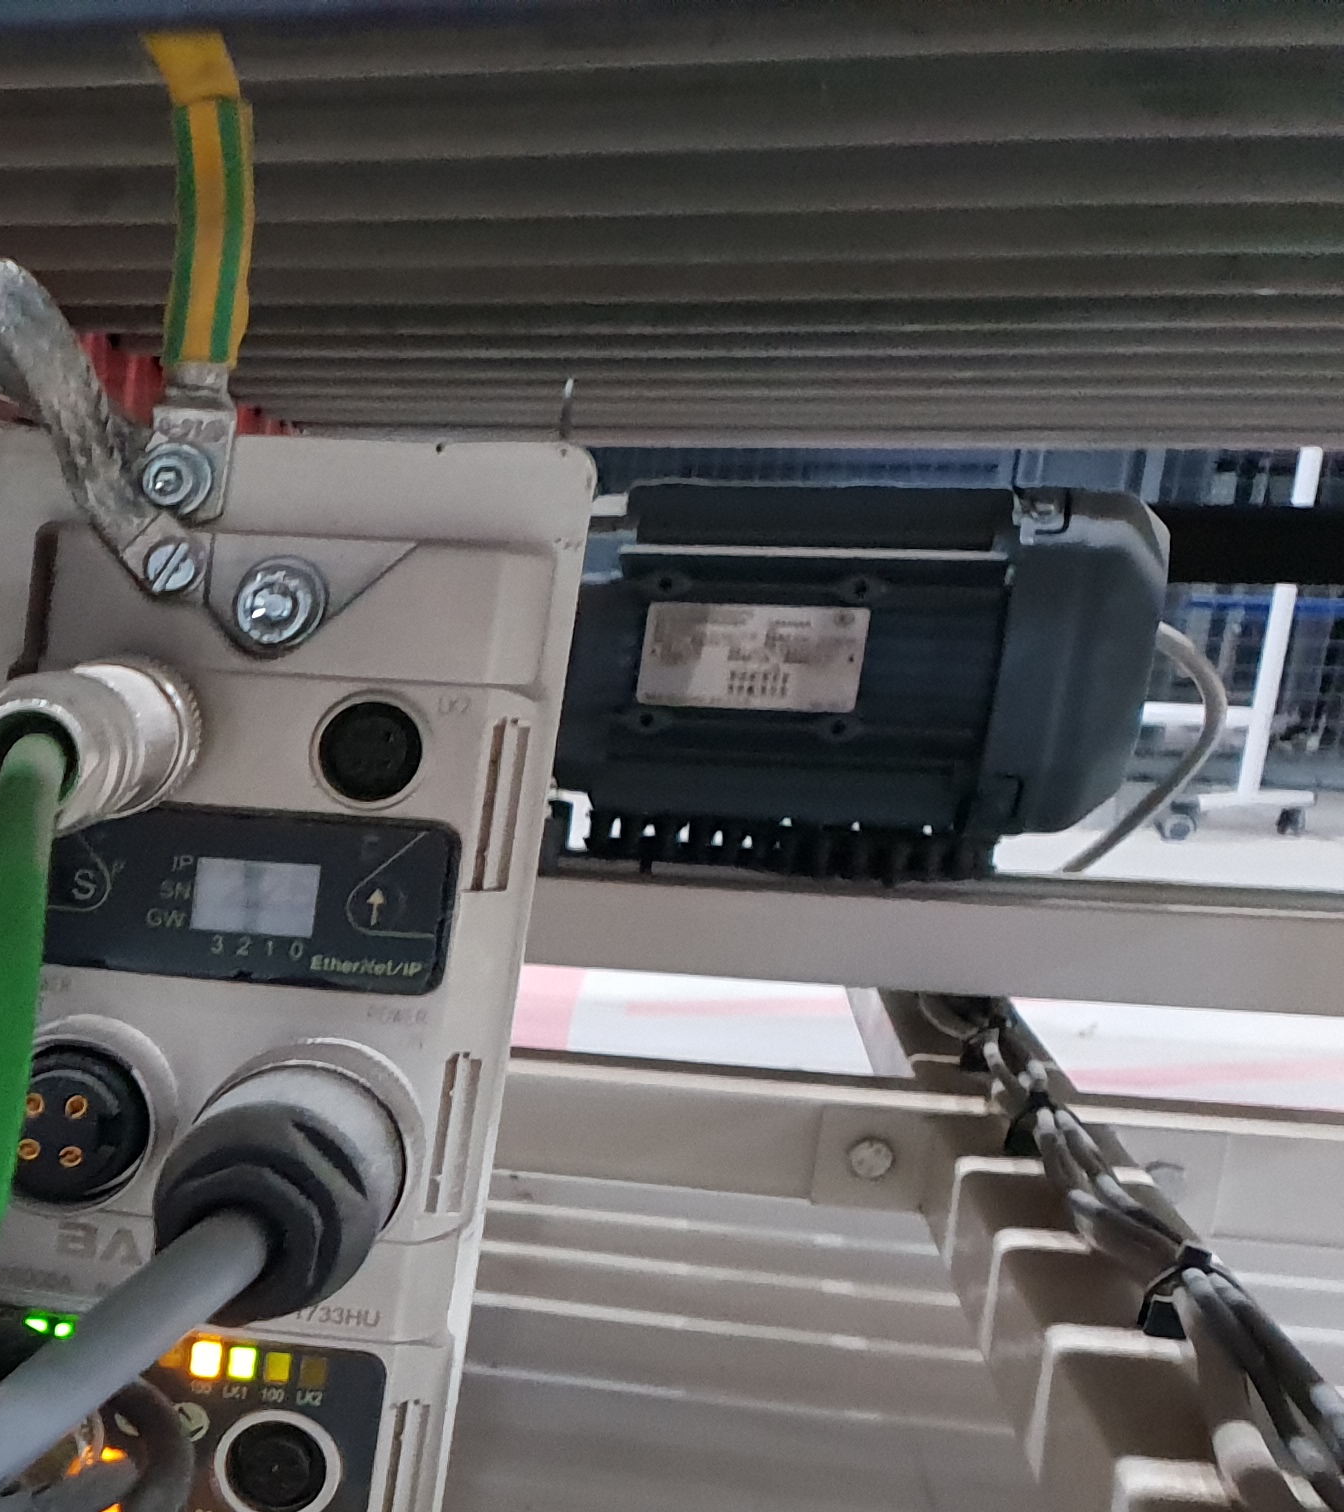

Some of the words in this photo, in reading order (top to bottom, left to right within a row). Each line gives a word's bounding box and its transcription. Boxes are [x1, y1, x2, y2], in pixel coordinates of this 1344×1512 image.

[171, 855, 194, 872] IP
[71, 868, 97, 901] S
[146, 907, 187, 929] GW
[211, 934, 225, 957] 3
[235, 935, 254, 957] 2
[265, 940, 274, 957] 1
[288, 940, 304, 960] 0
[310, 953, 423, 977] EtherNet/IP
[261, 1387, 286, 1404] 100
